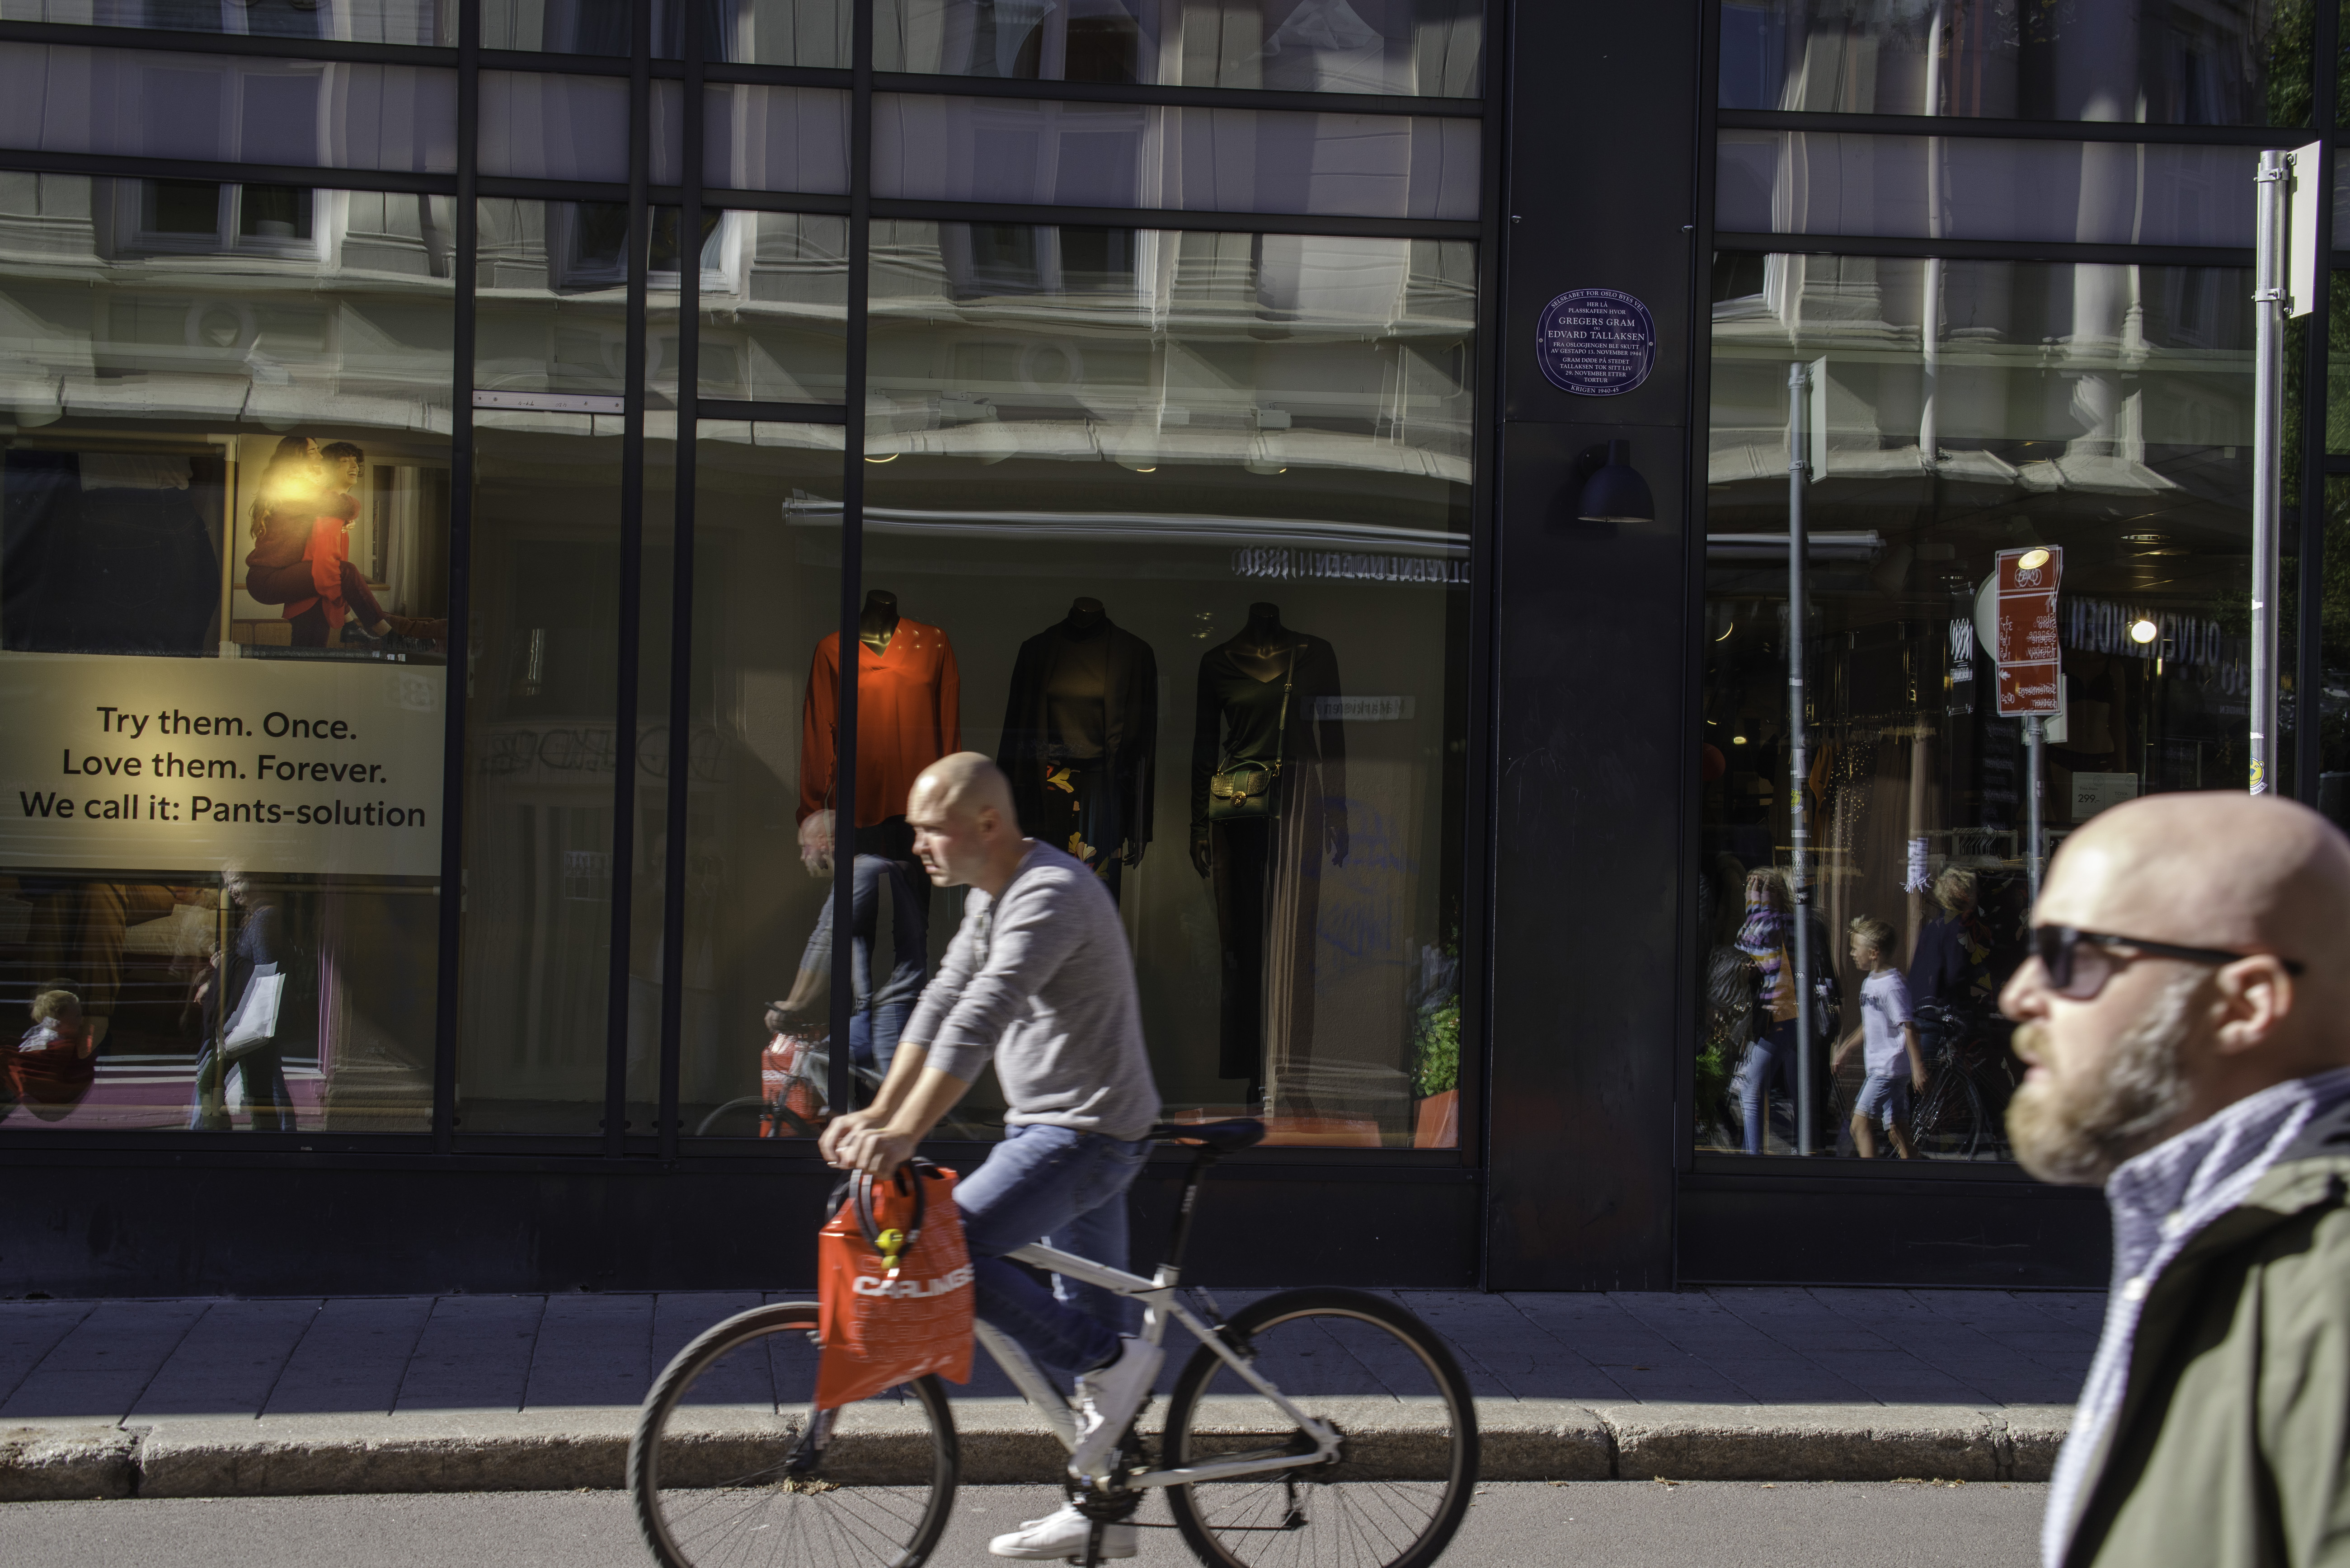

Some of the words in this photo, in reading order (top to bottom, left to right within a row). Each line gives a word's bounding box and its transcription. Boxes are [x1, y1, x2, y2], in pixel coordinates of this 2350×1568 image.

[1551, 291, 1584, 308] SELSKABET
[1619, 294, 1633, 303] BYES
[1634, 301, 1644, 312] VEL
[1559, 317, 1603, 325] GREGERS
[1590, 332, 1645, 341] TALLAKSEN
[96, 707, 149, 738] Try
[158, 709, 253, 737] them.
[262, 711, 357, 740] Once.
[63, 748, 142, 776] Love
[152, 751, 246, 780] them.
[257, 755, 387, 784] Forever.
[20, 791, 75, 817] We
[84, 793, 138, 820] call
[148, 793, 180, 821] it:
[191, 796, 426, 827] Pants-solution
